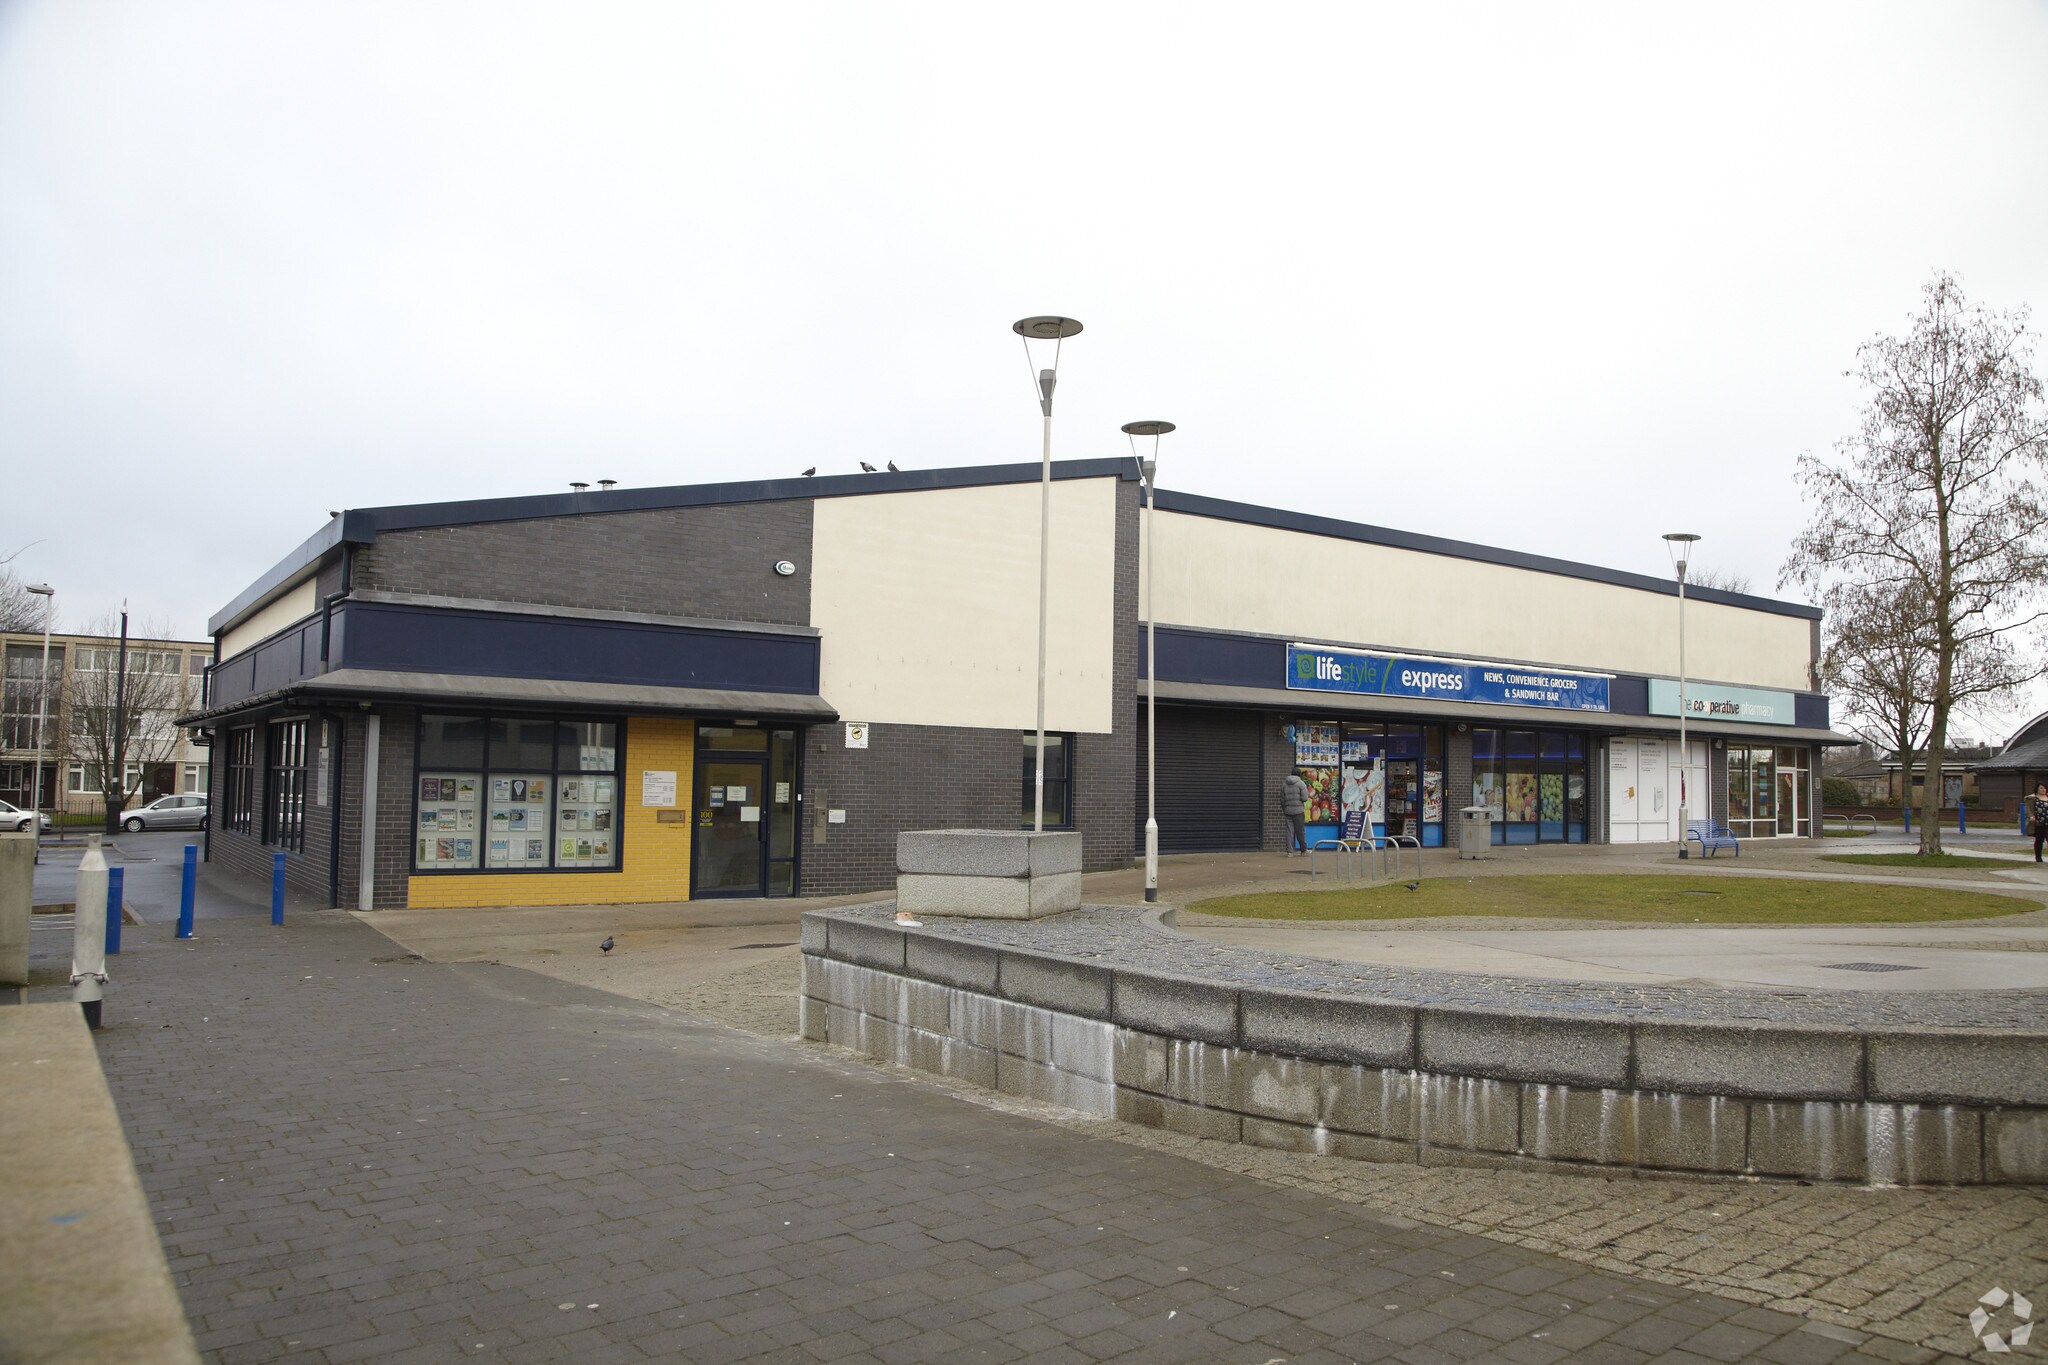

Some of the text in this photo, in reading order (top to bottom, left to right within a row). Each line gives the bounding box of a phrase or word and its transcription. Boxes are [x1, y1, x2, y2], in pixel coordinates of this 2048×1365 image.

[1316, 656, 1463, 693] lifestyle express
[1484, 671, 1578, 690] NEWS, CONVENIENCE GROCERS
[1504, 688, 1560, 701] & SANDWICH BAR
[1741, 701, 1774, 719] pharmacy
